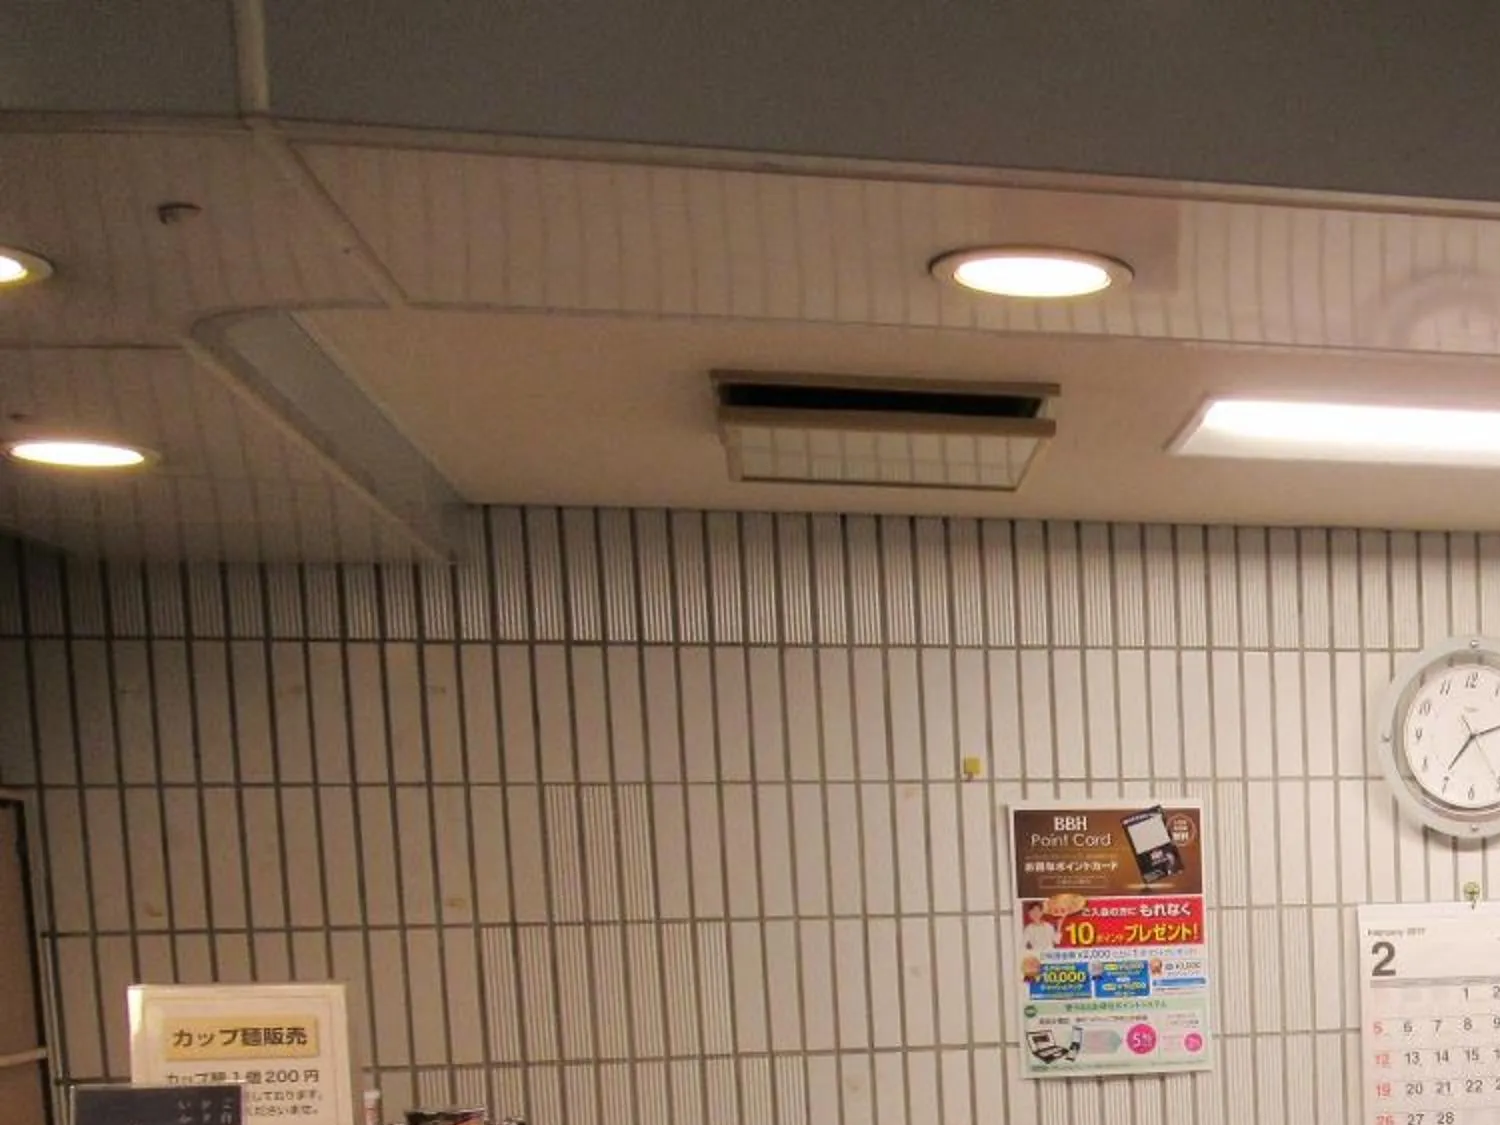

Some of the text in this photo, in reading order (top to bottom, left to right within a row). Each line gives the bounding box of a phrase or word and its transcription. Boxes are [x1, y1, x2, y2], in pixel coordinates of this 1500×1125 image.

[1053, 815, 1088, 831] BBH
[1031, 831, 1113, 848] Point Card
[1371, 940, 1397, 977] 2
[1463, 987, 1470, 1000] 1
[1492, 986, 1500, 999] 2
[1373, 1022, 1383, 1035] 5
[1403, 1020, 1413, 1034] 6
[1433, 1019, 1442, 1032] 7
[1463, 1018, 1473, 1031] 8
[171, 1025, 309, 1048] カップ麺販売
[1375, 1053, 1390, 1066] 12
[1405, 1051, 1420, 1066] 13
[1435, 1050, 1449, 1064] 14
[1465, 1048, 1480, 1062] 15
[1375, 1083, 1391, 1097] 19
[1406, 1082, 1423, 1096] 20
[1436, 1081, 1451, 1095] 21
[1466, 1079, 1483, 1093] 22
[1437, 1112, 1455, 1125] 28
